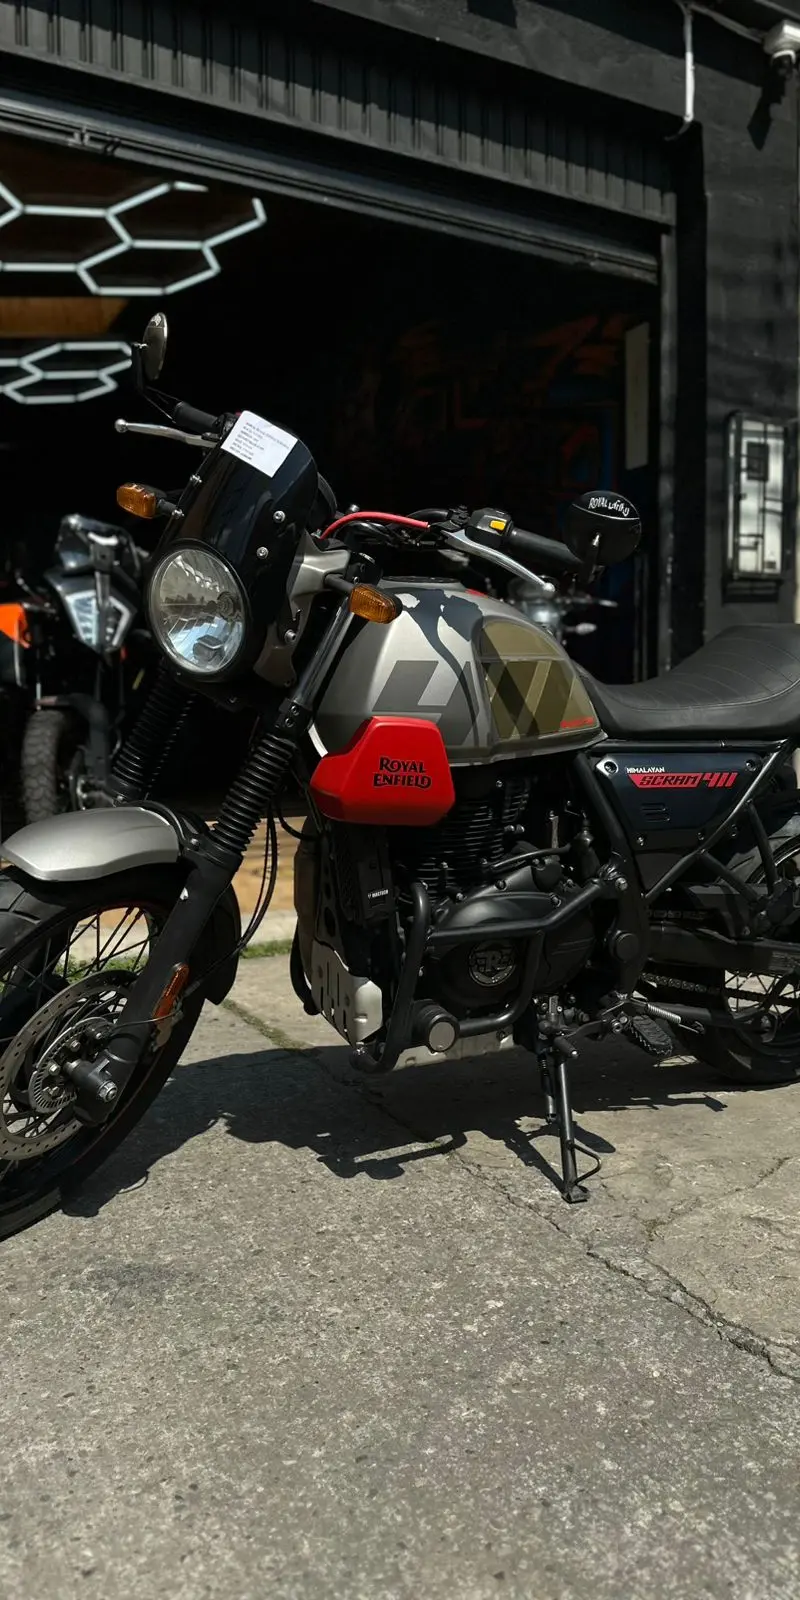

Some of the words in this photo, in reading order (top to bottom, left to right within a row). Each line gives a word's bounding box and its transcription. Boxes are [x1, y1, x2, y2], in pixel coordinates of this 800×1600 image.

[379, 756, 426, 773] ROYAL
[626, 766, 665, 774] HIMALAYAN
[373, 773, 432, 789] ENFIELD
[640, 775, 698, 786] SCRAM
[699, 772, 739, 788] 411
